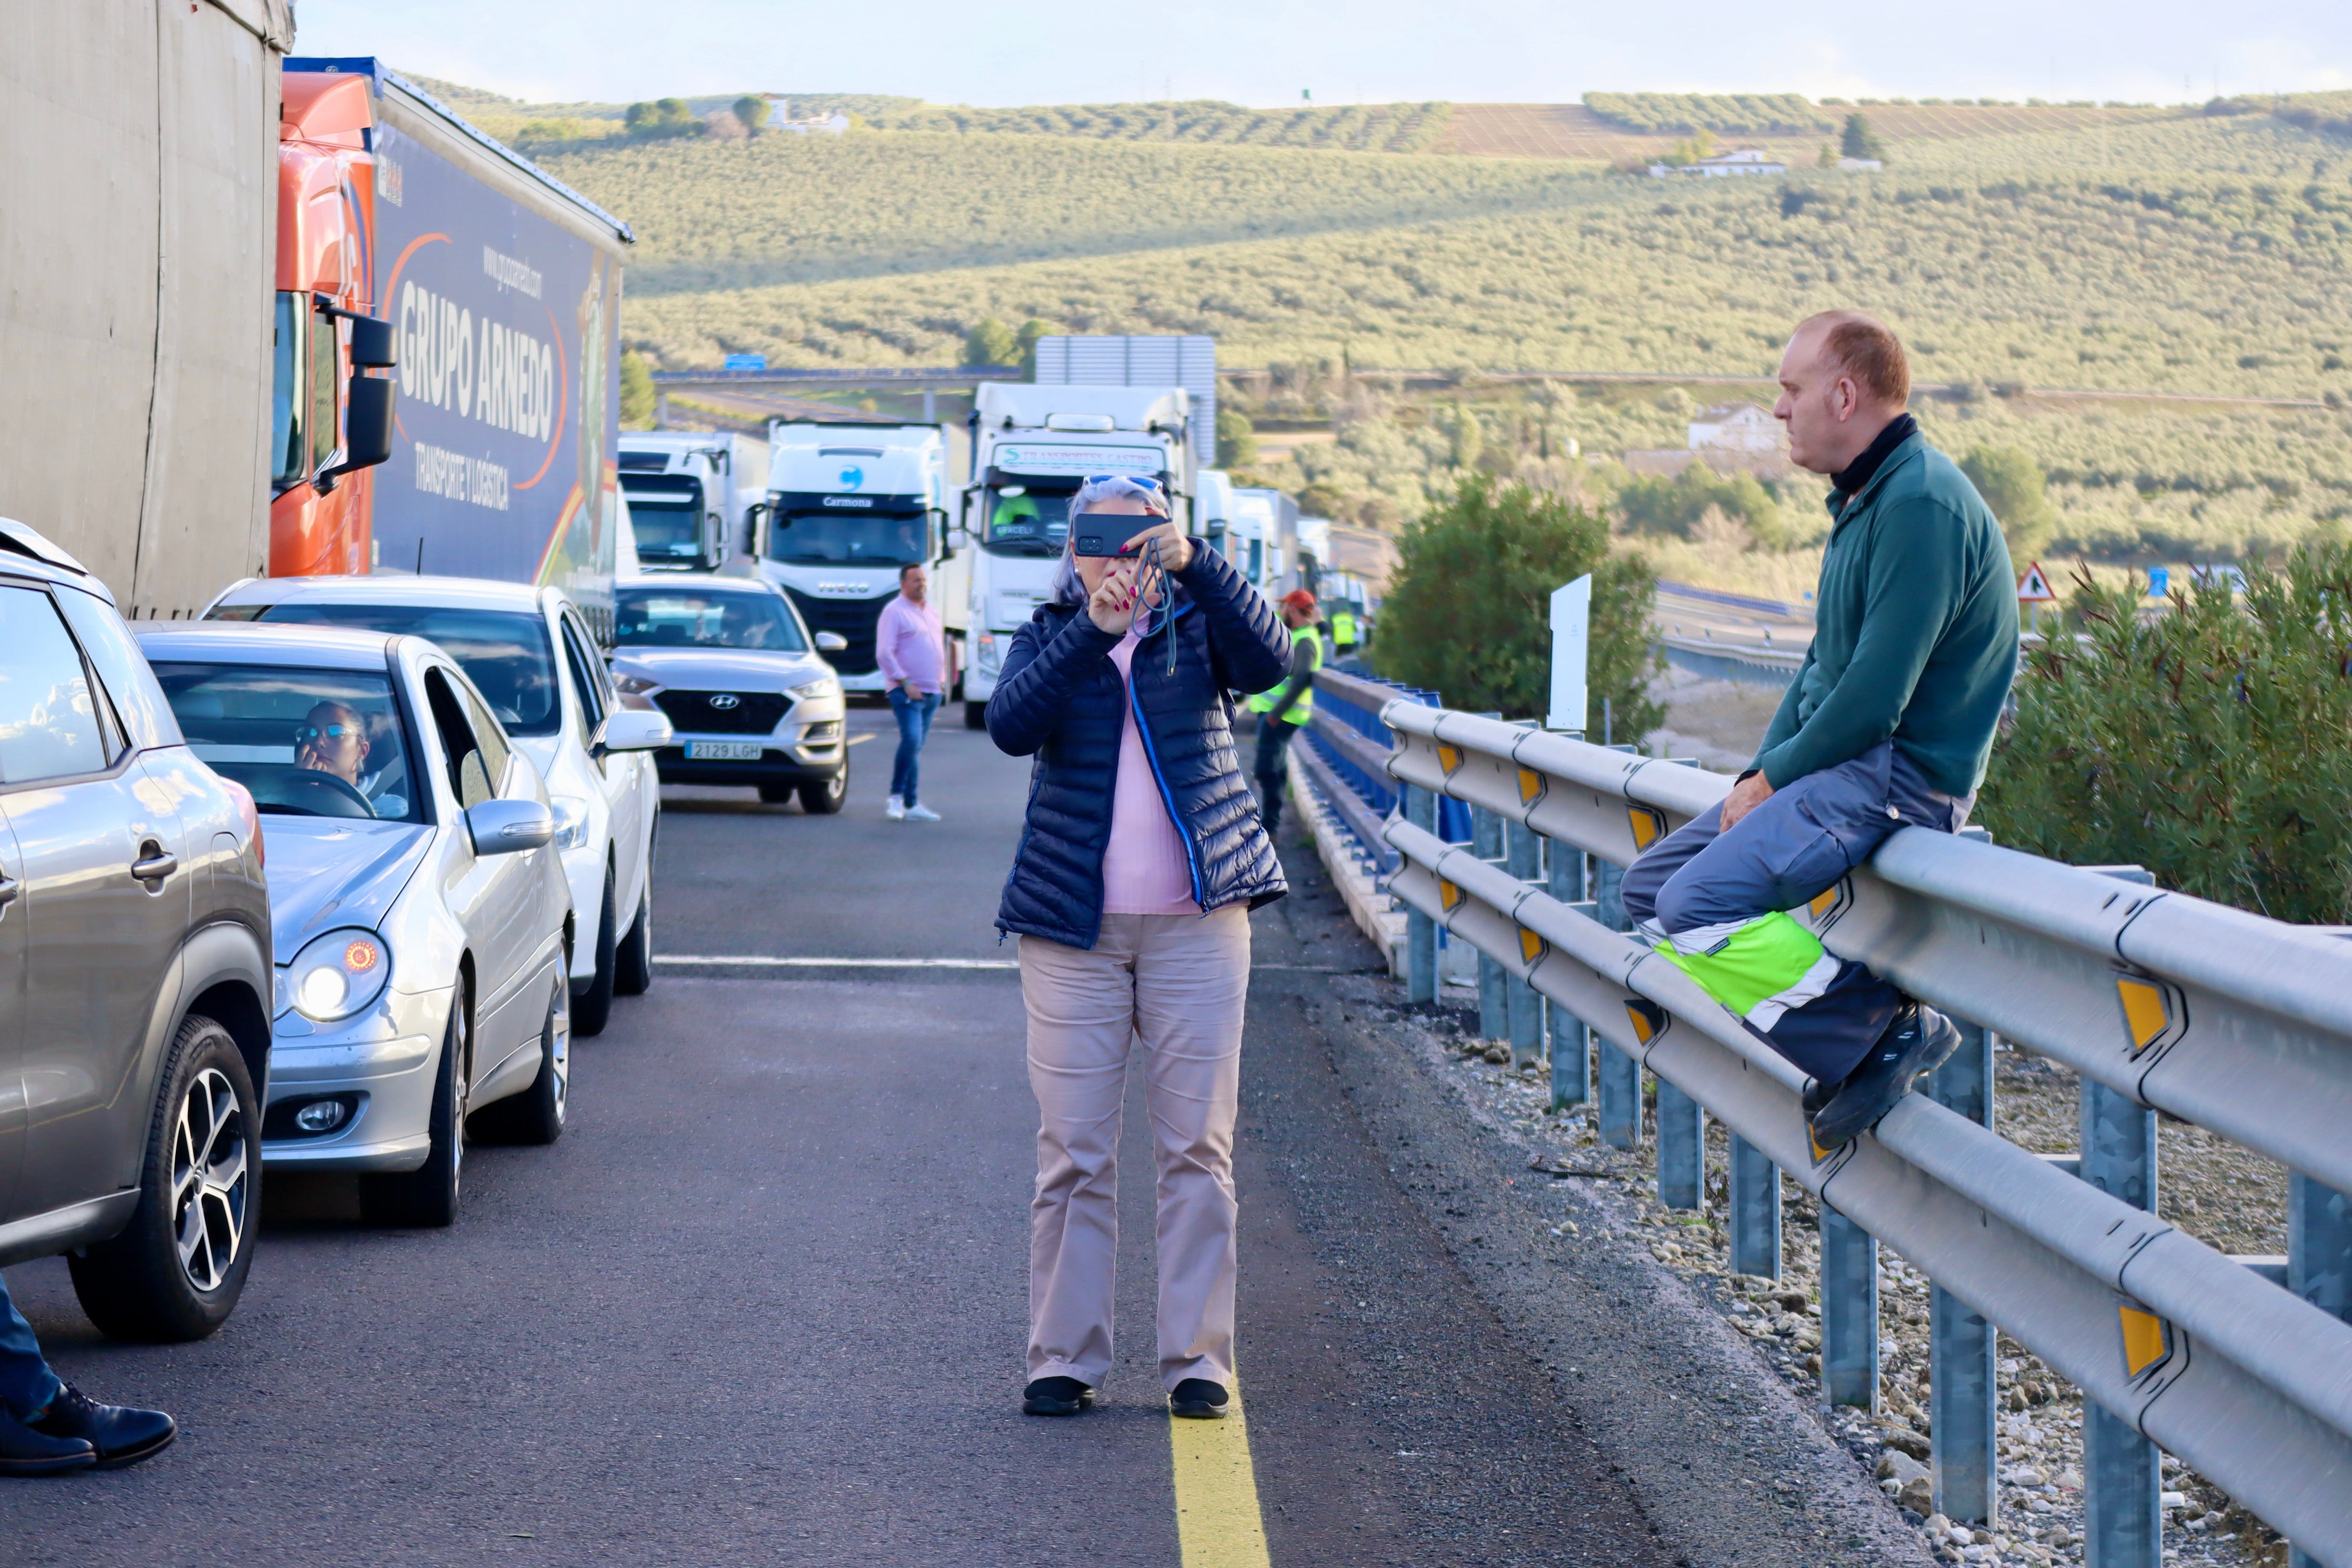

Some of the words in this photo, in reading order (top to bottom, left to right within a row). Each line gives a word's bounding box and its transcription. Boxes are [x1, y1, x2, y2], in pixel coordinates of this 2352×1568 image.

[400, 280, 472, 417] GRUPO
[476, 317, 553, 443] ARNEDO
[1023, 451, 1103, 463] TRANSPORTES
[1107, 454, 1151, 465] CASTRO
[415, 442, 465, 501] TRANSPORTE
[466, 457, 472, 502] Y
[472, 450, 508, 511] LOGÍSTICA
[823, 497, 873, 508] Carmona
[819, 582, 869, 593] IVECO
[694, 744, 728, 757] 2129
[733, 745, 759, 757] LGH
